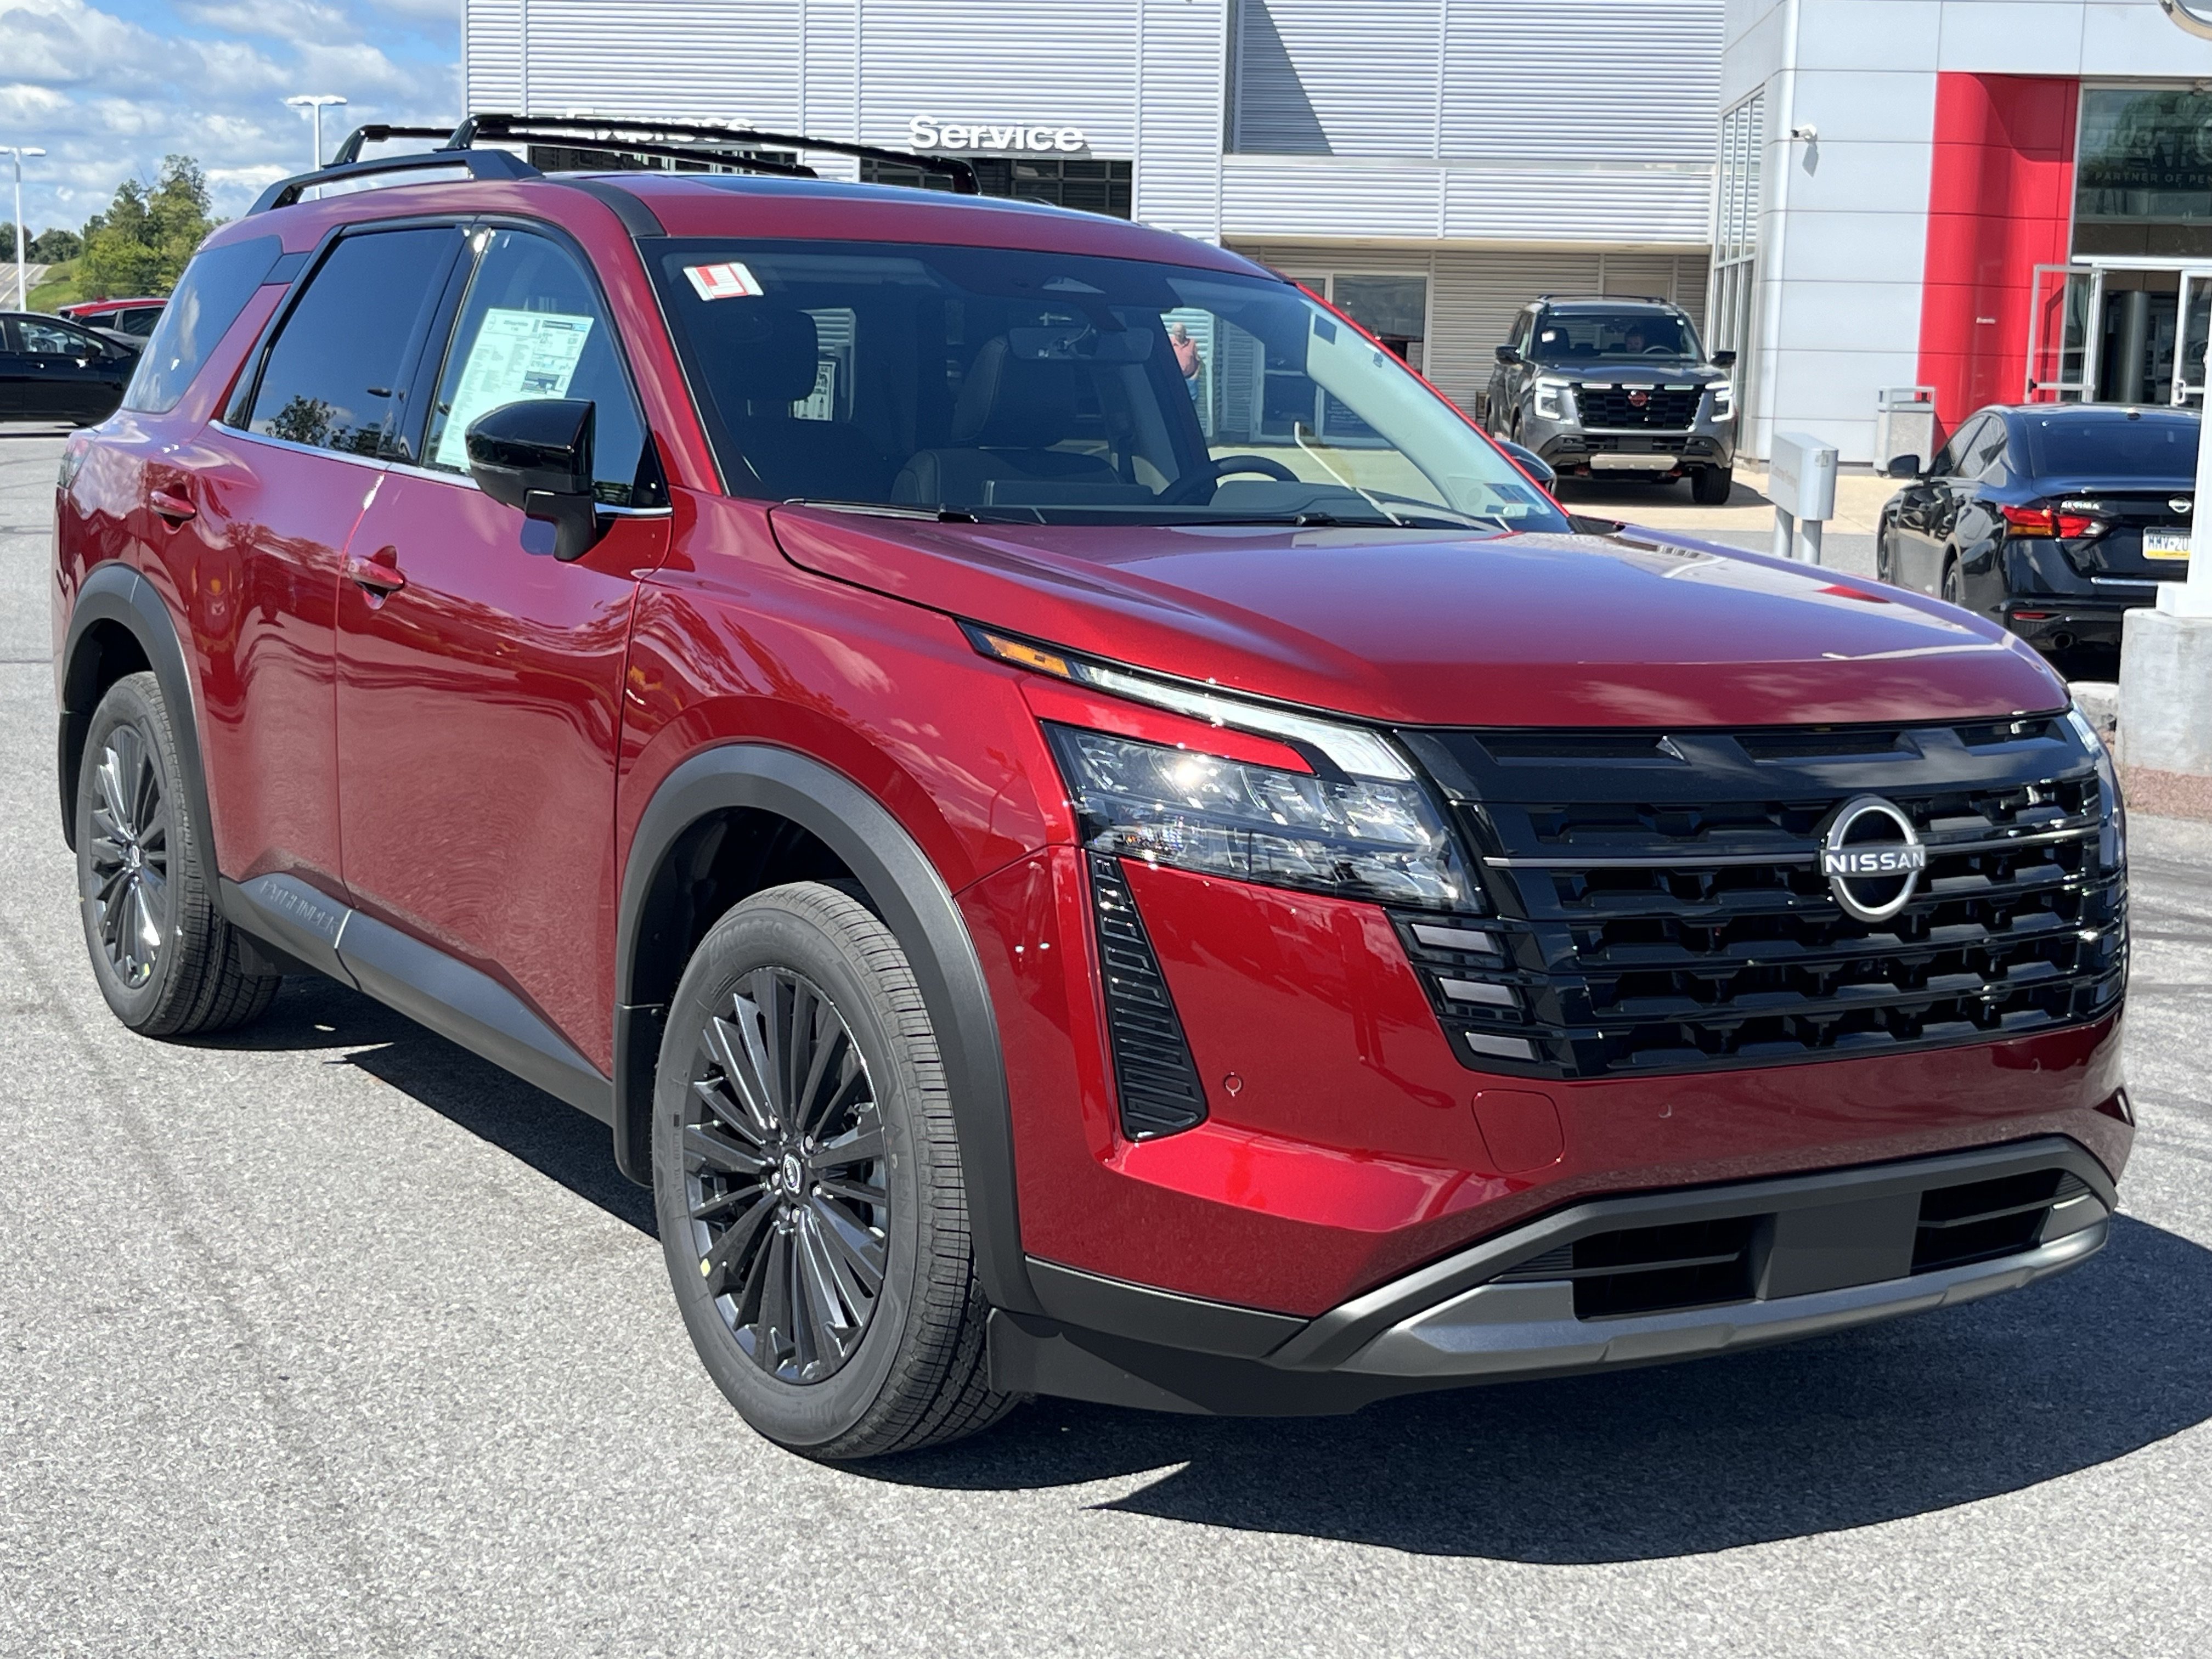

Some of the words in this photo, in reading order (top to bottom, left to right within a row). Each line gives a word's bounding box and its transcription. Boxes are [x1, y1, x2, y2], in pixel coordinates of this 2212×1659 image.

[908, 115, 1085, 151] Service
[2095, 172, 2158, 183] PARTNER
[2164, 173, 2183, 183] OF
[1825, 851, 1925, 873] NISSAN
